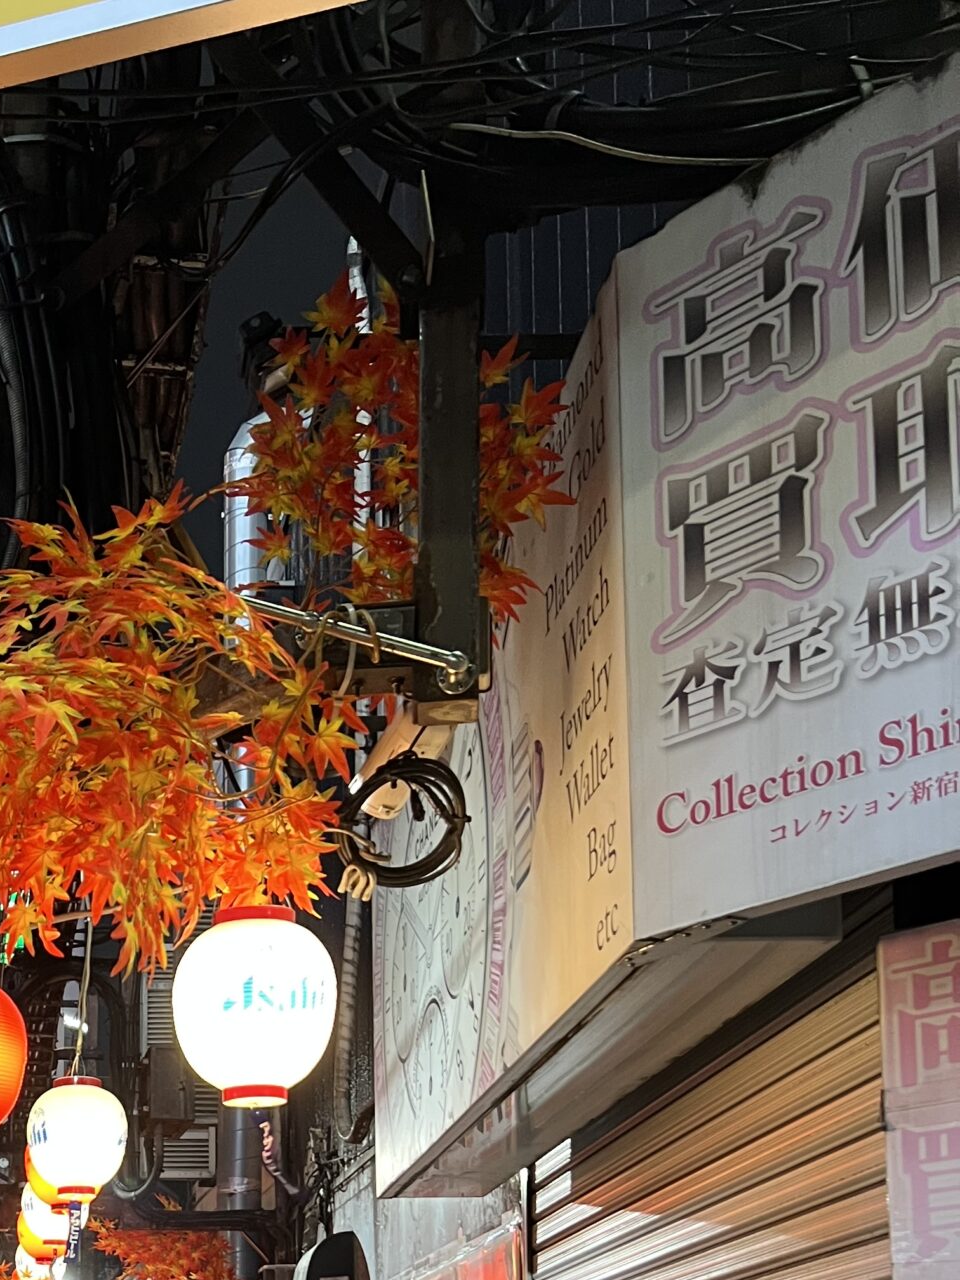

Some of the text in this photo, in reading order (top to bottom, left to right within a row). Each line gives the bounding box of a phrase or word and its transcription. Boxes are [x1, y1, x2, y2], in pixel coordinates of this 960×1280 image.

[568, 396, 606, 504] Gold
[545, 497, 608, 637] Platinum
[562, 566, 610, 676] Watch
[559, 653, 614, 777] Jewelry
[566, 733, 615, 826] Wallet
[656, 746, 866, 836] Collection
[587, 819, 618, 883] Bag
[595, 902, 619, 953] etc
